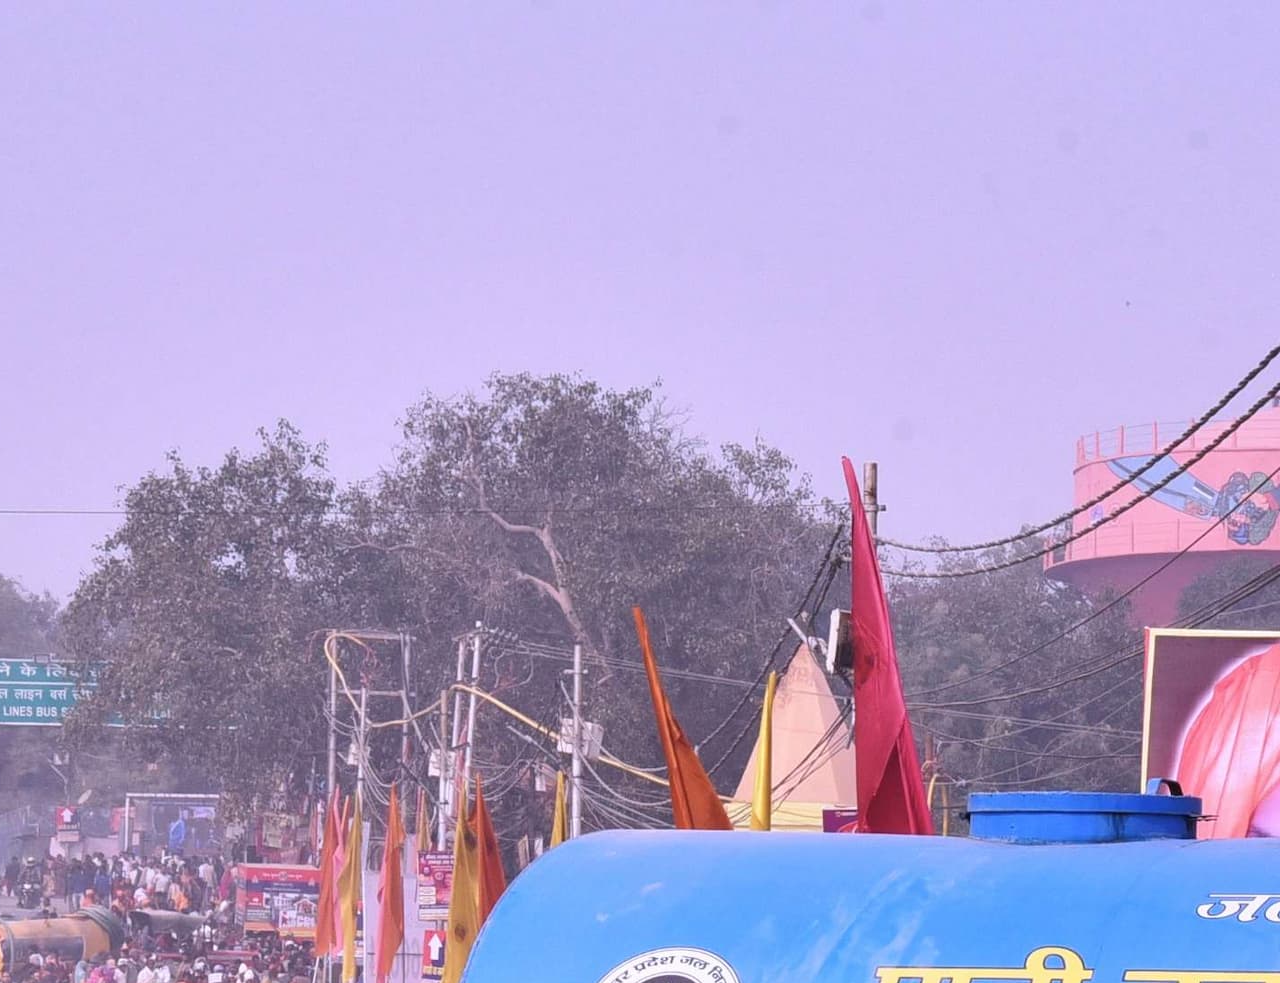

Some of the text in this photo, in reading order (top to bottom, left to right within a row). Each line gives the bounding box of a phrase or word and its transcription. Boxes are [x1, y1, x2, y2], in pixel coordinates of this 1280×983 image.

[19, 661, 37, 678] के
[14, 686, 43, 701] लाइन
[3, 706, 34, 718] LINES
[36, 706, 58, 718] BUS
[634, 955, 677, 973] प्रदेश
[679, 955, 710, 970] जल
